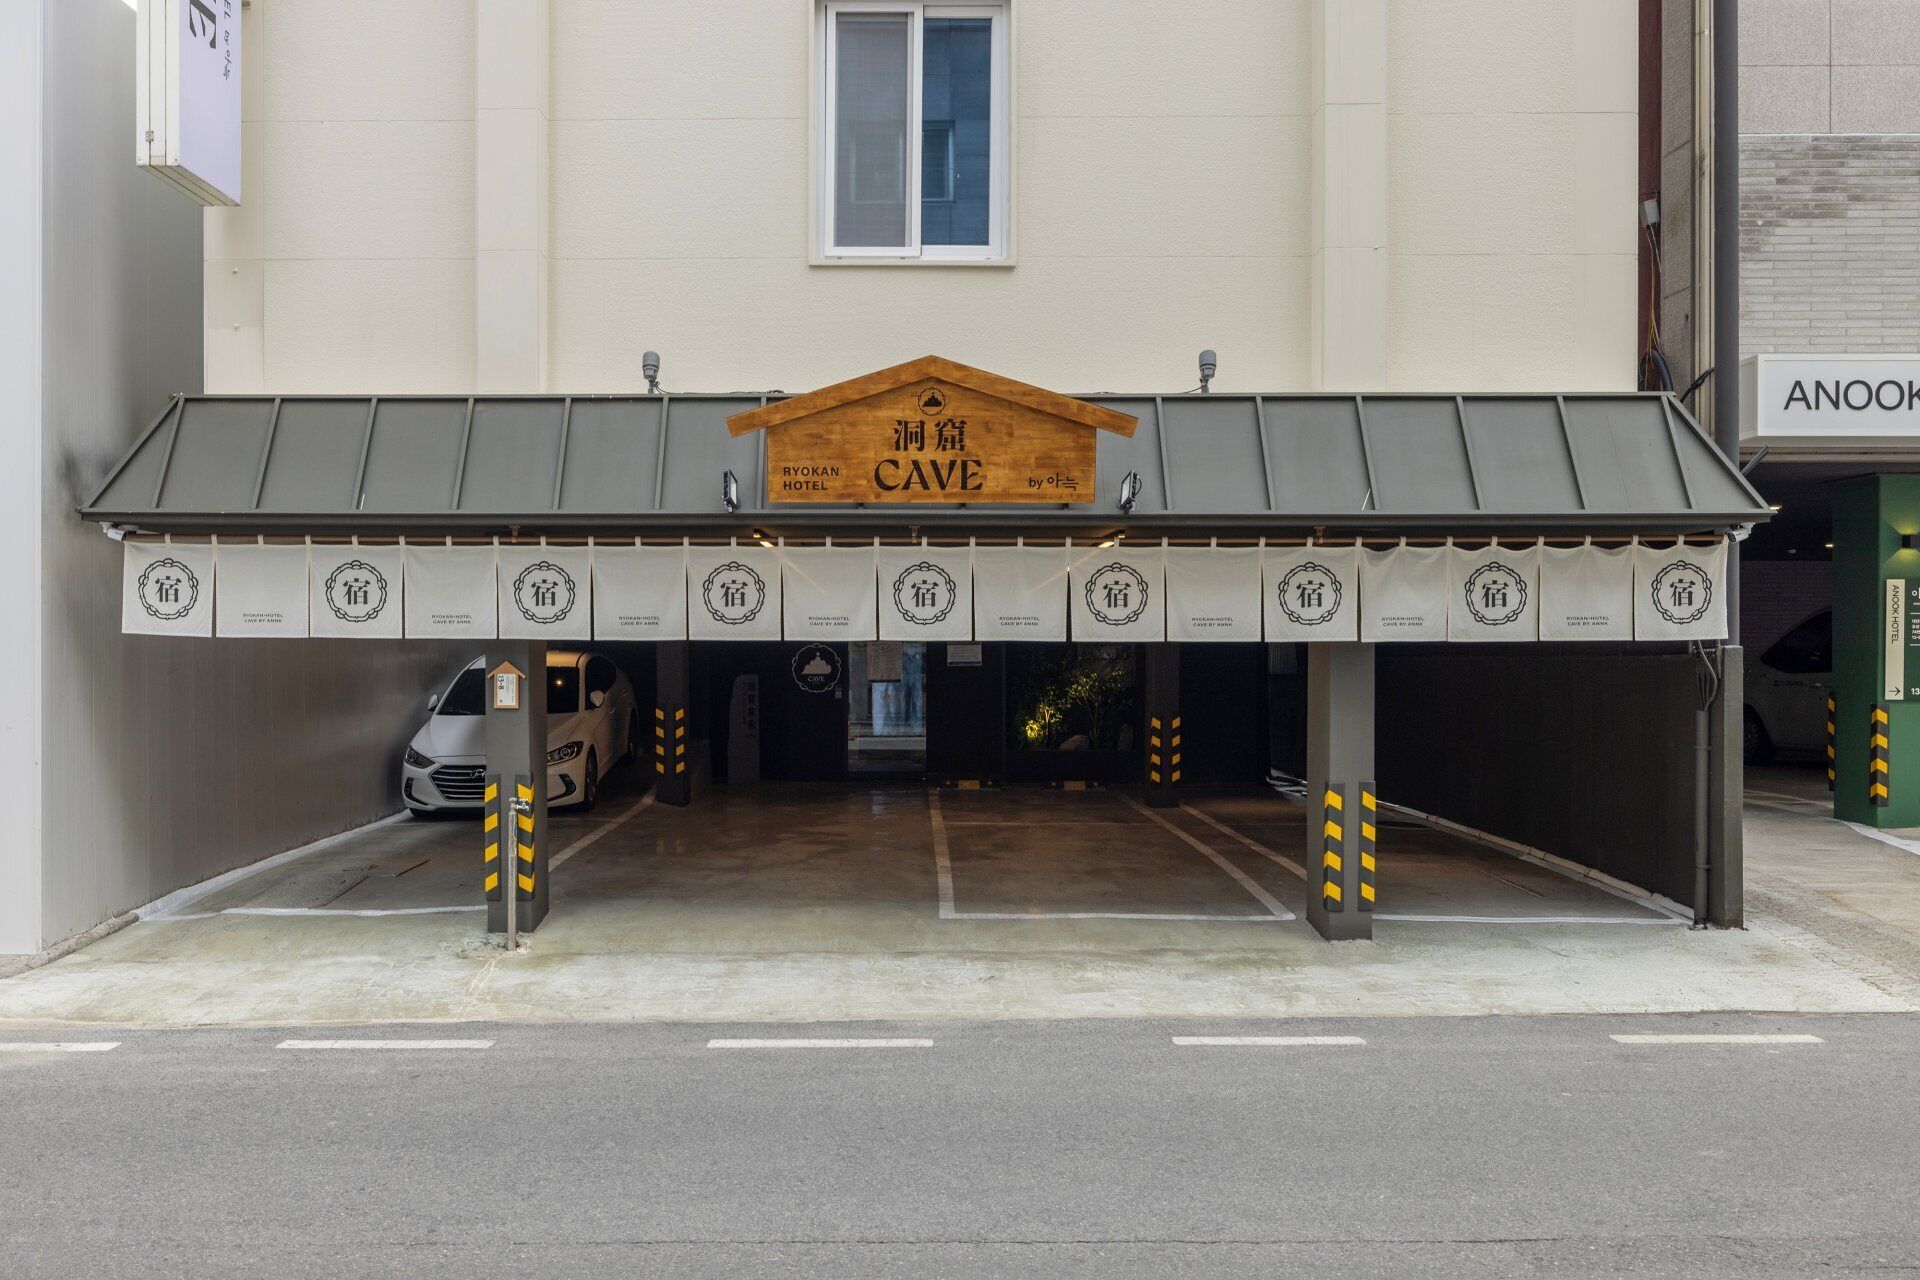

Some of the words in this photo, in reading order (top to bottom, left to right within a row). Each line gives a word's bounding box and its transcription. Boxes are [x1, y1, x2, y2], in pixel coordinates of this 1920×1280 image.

[894, 419, 967, 451] 洞窟
[784, 467, 839, 476] RYOKAN
[874, 459, 983, 491] CAVE
[784, 481, 828, 490] HOTEL
[1029, 477, 1043, 490] by
[1047, 472, 1079, 492] 아늑
